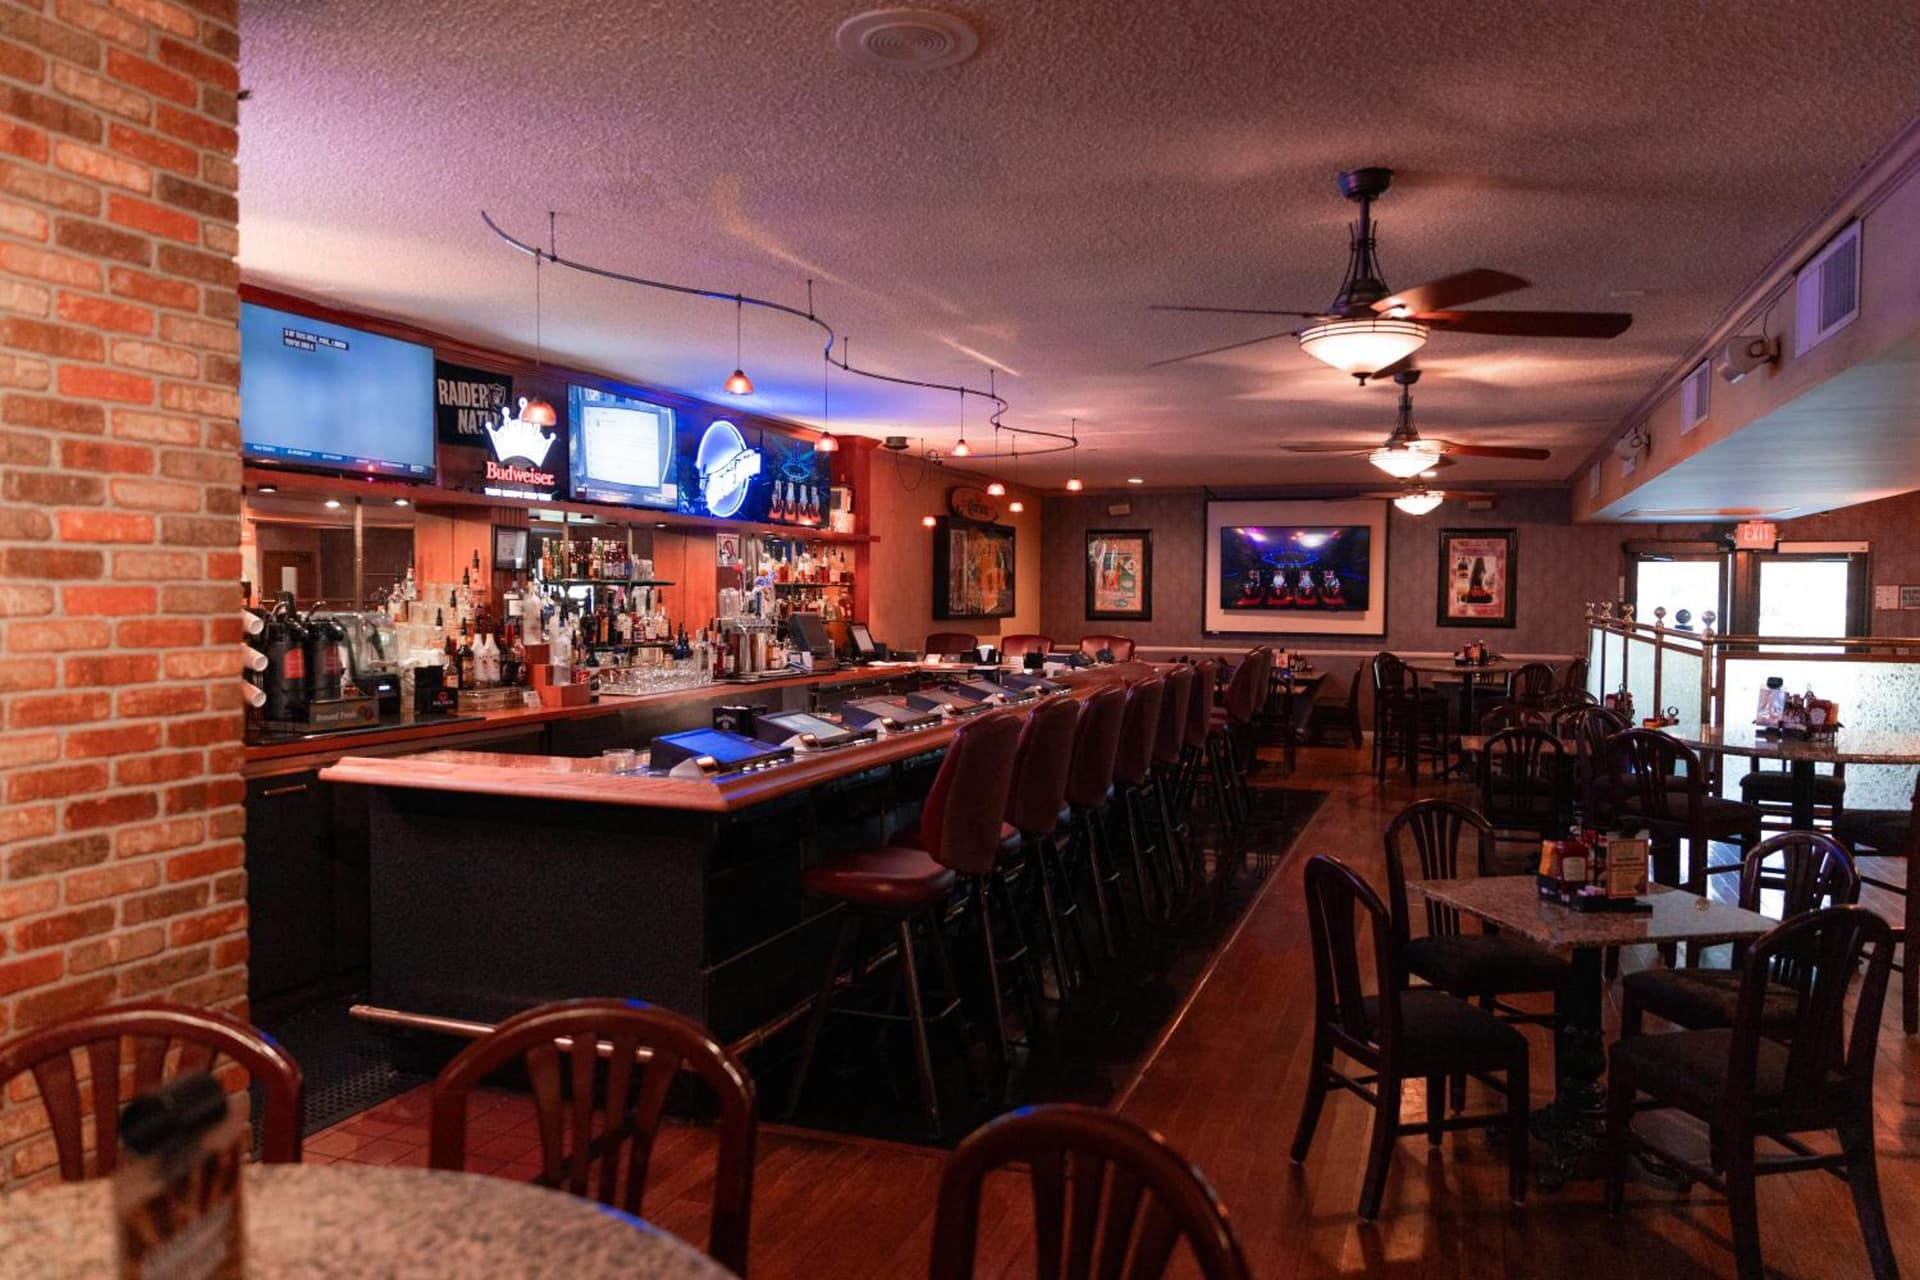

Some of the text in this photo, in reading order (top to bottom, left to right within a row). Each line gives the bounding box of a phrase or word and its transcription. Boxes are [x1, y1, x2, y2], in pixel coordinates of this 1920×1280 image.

[437, 378, 489, 408] RAIDER
[458, 409, 500, 435] NAT
[486, 461, 554, 485] Budweiser
[1743, 524, 1772, 542] EXIT
